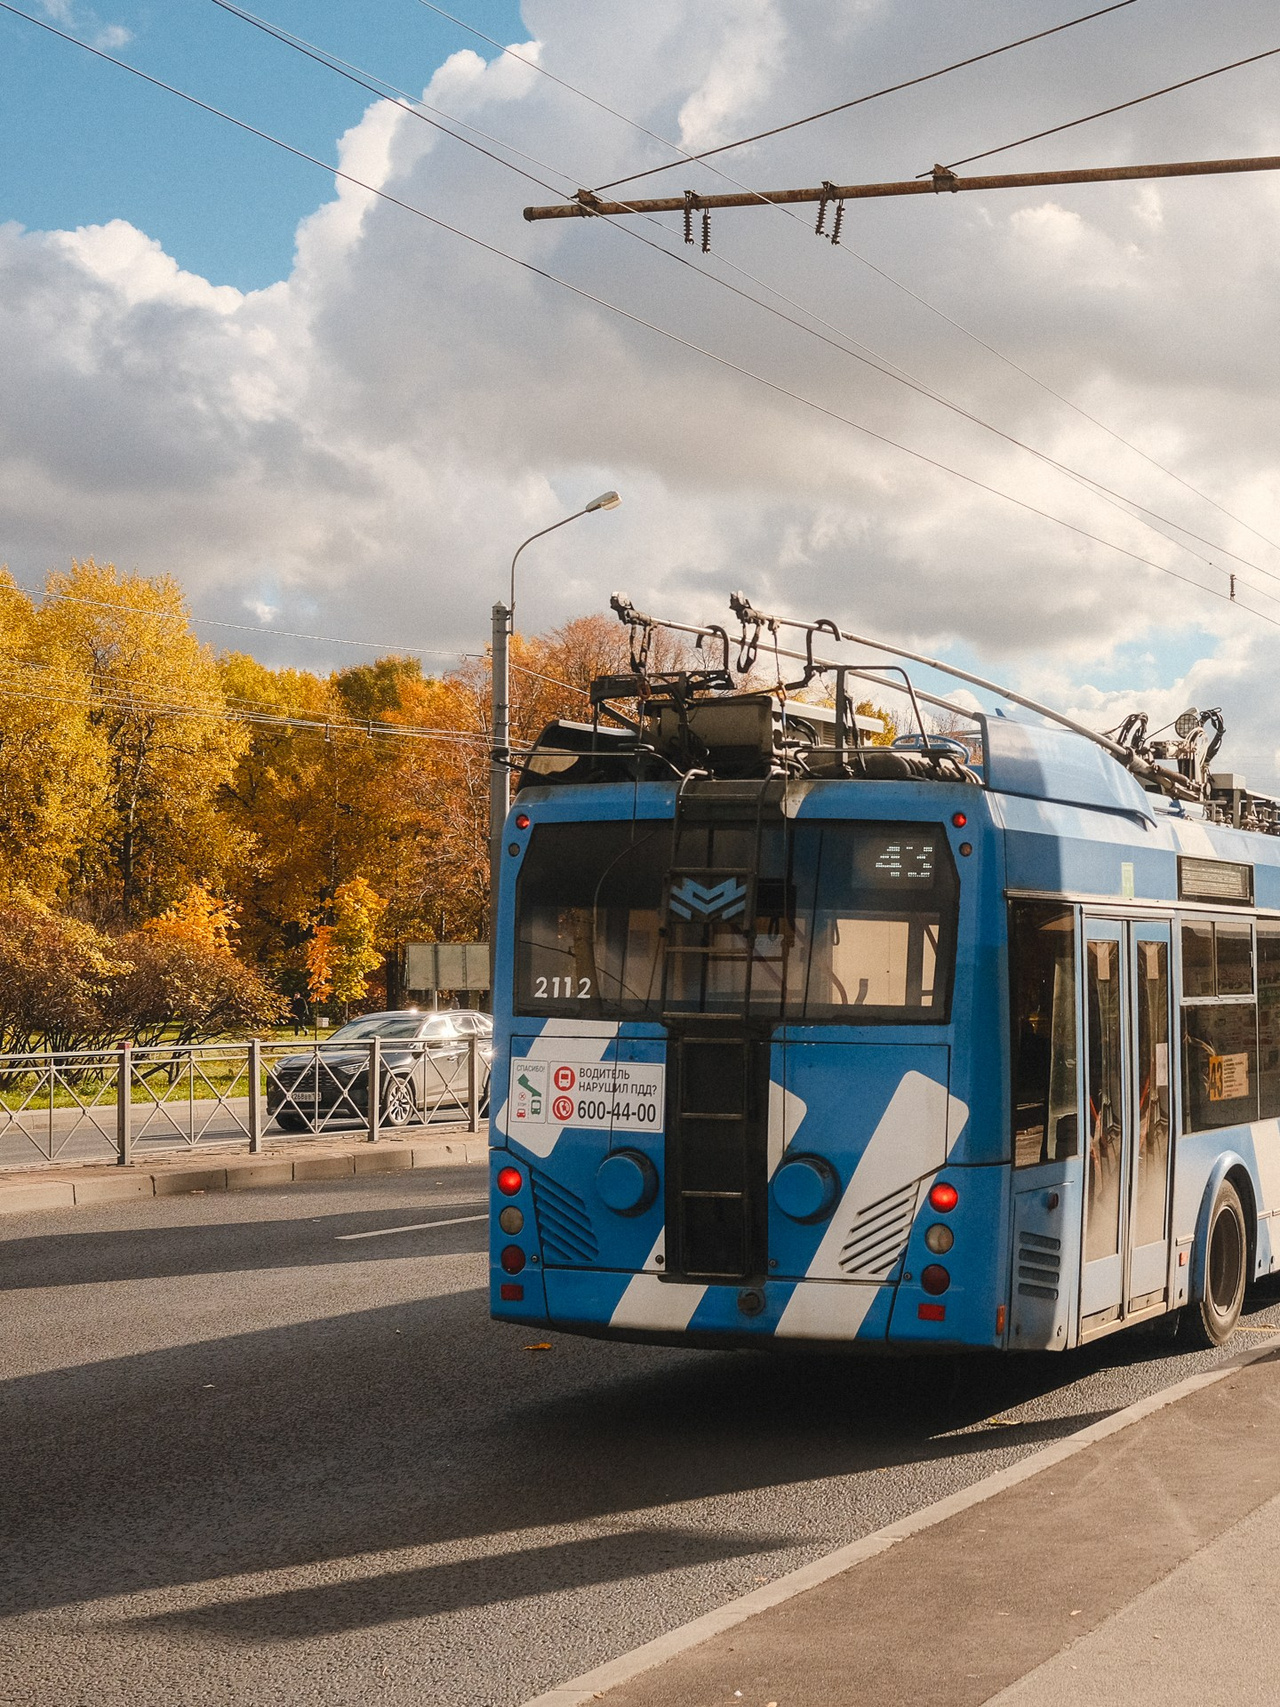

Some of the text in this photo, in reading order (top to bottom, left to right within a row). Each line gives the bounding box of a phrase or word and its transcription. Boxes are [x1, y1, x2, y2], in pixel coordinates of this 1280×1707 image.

[534, 976, 591, 999] 2112
[516, 1064, 546, 1073] СПАСИБО!
[579, 1067, 630, 1081] ВОДИТЕЛЬ
[578, 1082, 658, 1097] НАРУШИЛ ПДД?
[577, 1100, 656, 1123] 600-44-00
